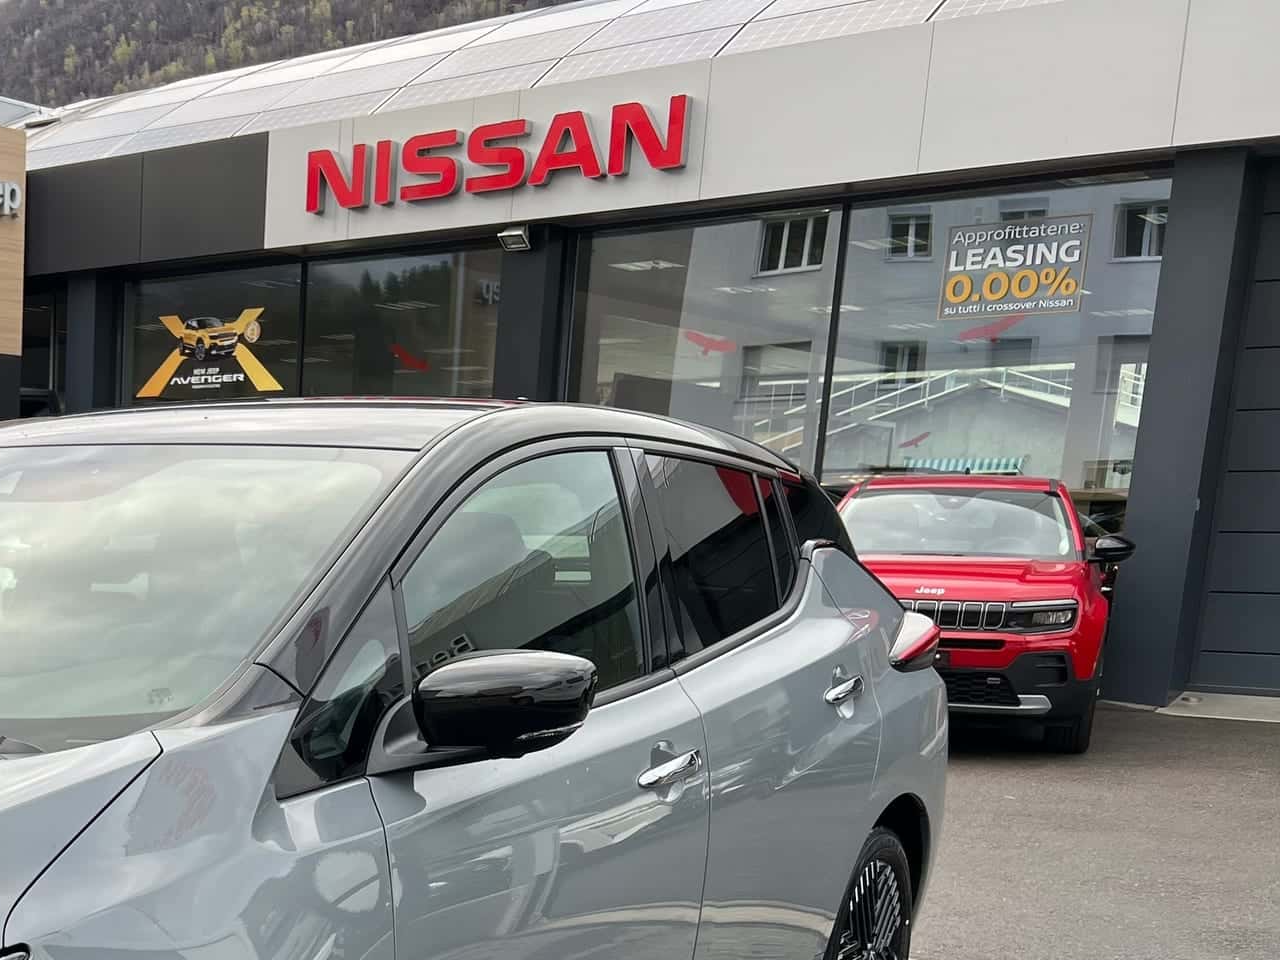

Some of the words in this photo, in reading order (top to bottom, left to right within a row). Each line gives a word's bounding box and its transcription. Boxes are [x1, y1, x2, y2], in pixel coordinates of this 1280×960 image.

[306, 94, 691, 215] NISSAN
[952, 222, 1084, 246] Approfittatene:
[948, 239, 1081, 272] LEASING
[945, 265, 1078, 304] 0.00%
[943, 306, 956, 315] su
[958, 303, 980, 314] tutti
[987, 301, 1036, 312] crossover
[1038, 298, 1074, 309] Nissan
[169, 373, 245, 385] AVENGER
[915, 586, 945, 596] Jeep
